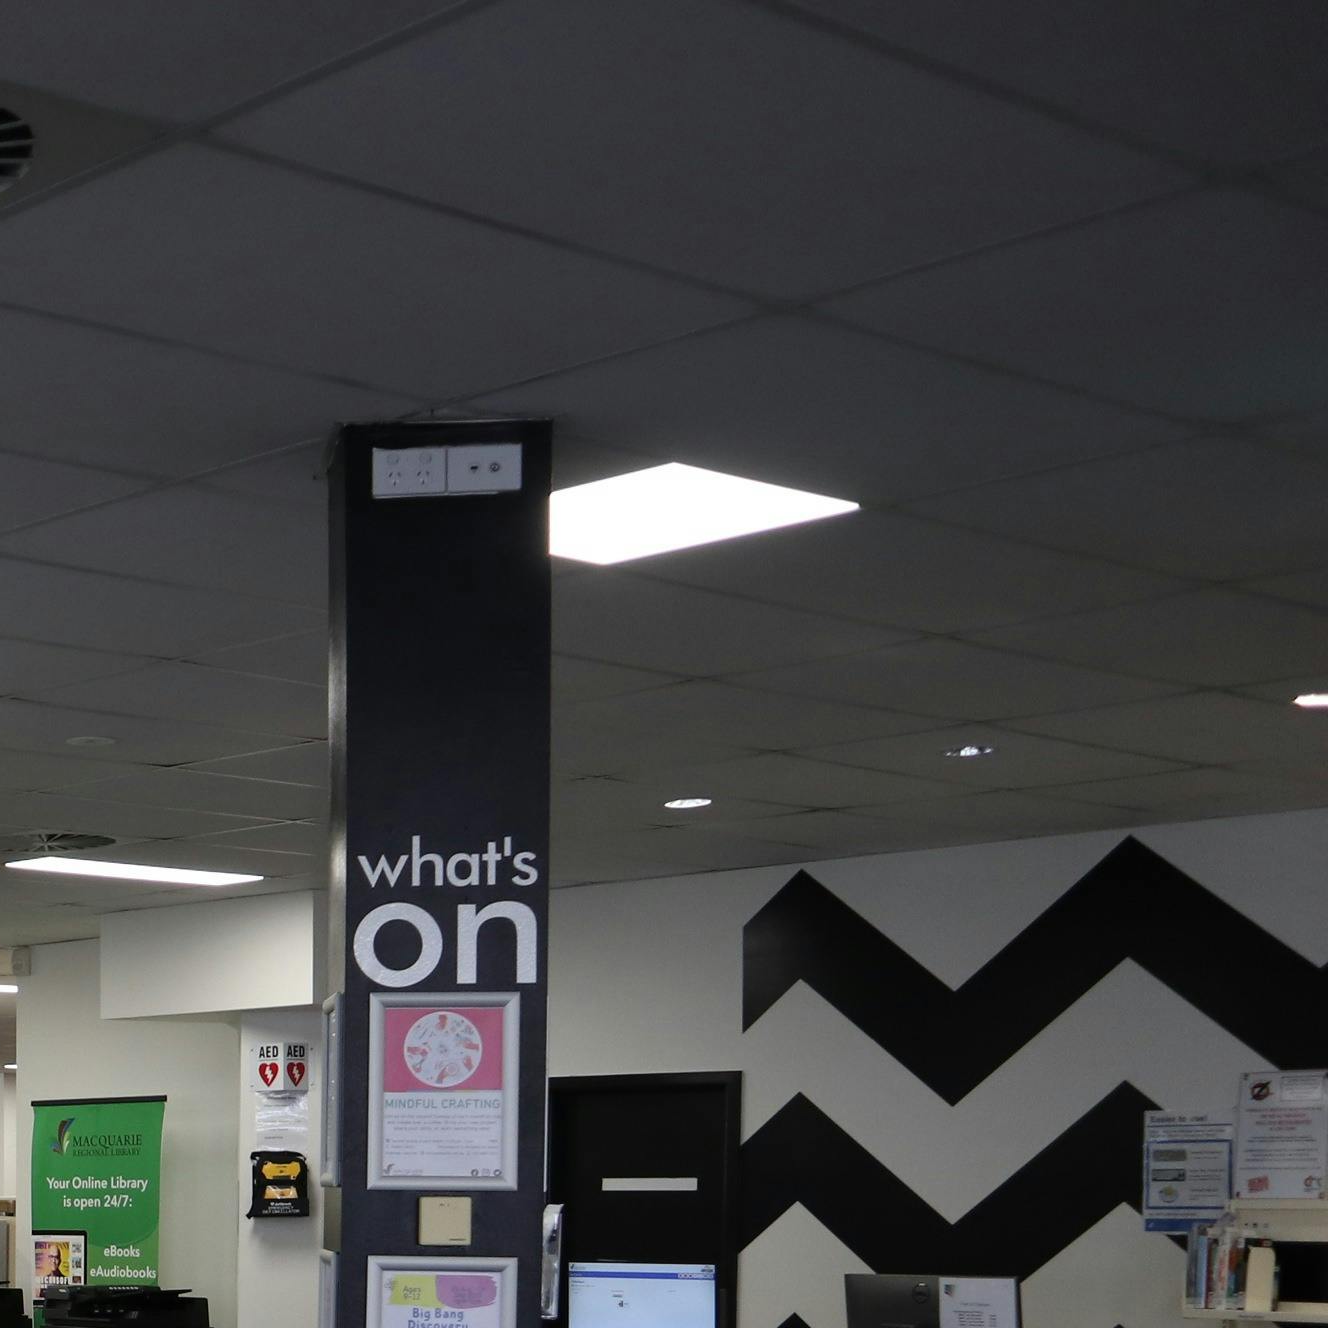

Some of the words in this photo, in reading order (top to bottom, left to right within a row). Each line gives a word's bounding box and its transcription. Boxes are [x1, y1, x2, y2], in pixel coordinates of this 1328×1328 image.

[357, 835, 538, 887] what's
[353, 900, 537, 987] on
[259, 1046, 278, 1058] AED
[287, 1045, 305, 1057] AED
[385, 1099, 437, 1109] MINDFUL
[441, 1099, 500, 1109] CRAFTING
[73, 1135, 142, 1147] MACQUARIE
[47, 1177, 70, 1189] Your
[72, 1177, 107, 1189] Online
[111, 1177, 148, 1192] Library
[63, 1196, 71, 1207] is
[74, 1197, 100, 1210] open
[104, 1195, 133, 1208] 24/7:
[104, 1245, 140, 1257] eBooks
[90, 1266, 156, 1279] eAudiobooks
[412, 1308, 431, 1321] Big
[434, 1308, 464, 1322] Bang
